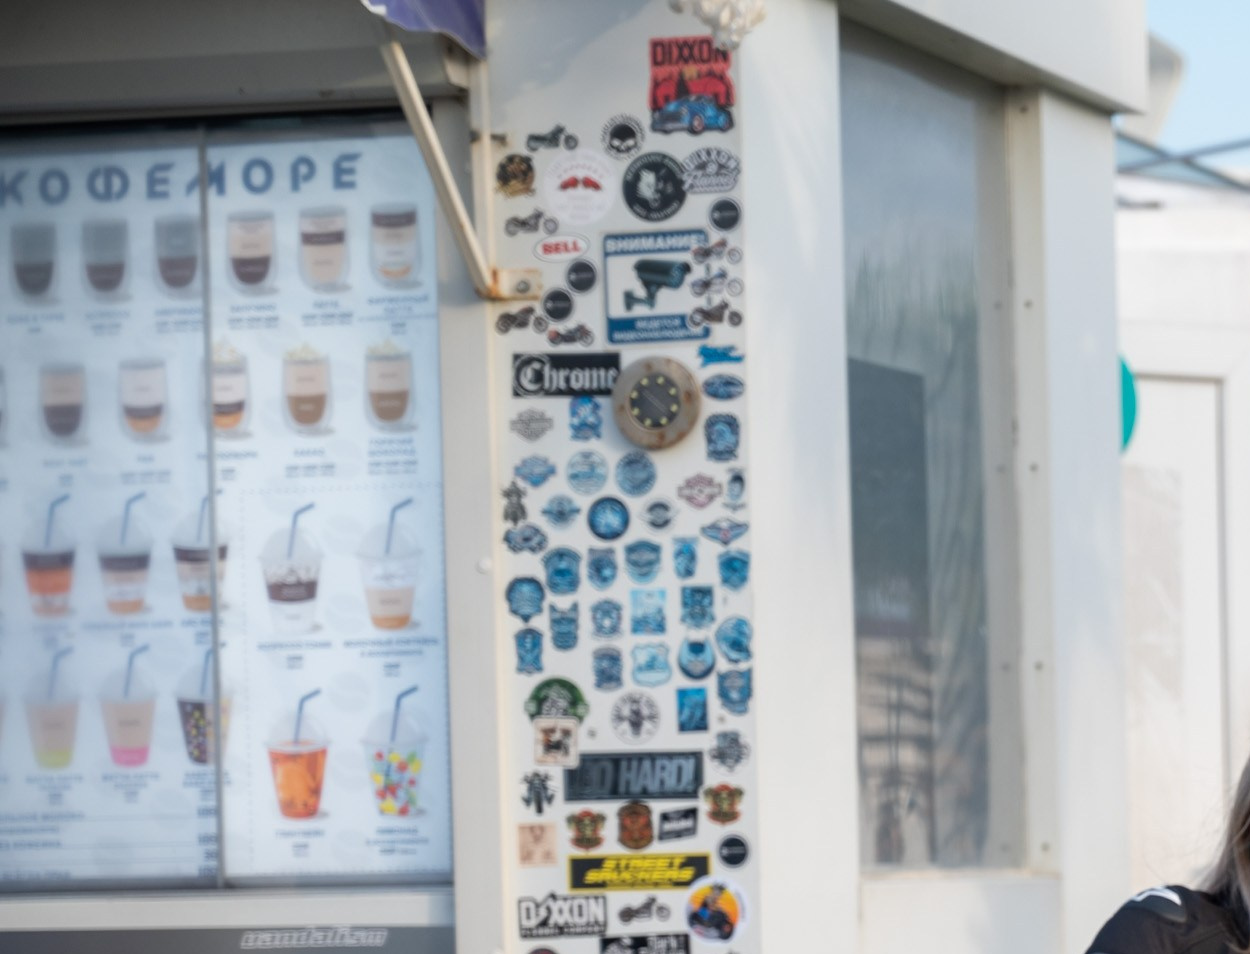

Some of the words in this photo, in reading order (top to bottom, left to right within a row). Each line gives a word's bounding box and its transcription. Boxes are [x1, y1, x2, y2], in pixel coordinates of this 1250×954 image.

[652, 39, 728, 66] DIXXON
[541, 240, 581, 256] BELL
[517, 356, 618, 393] Chrome
